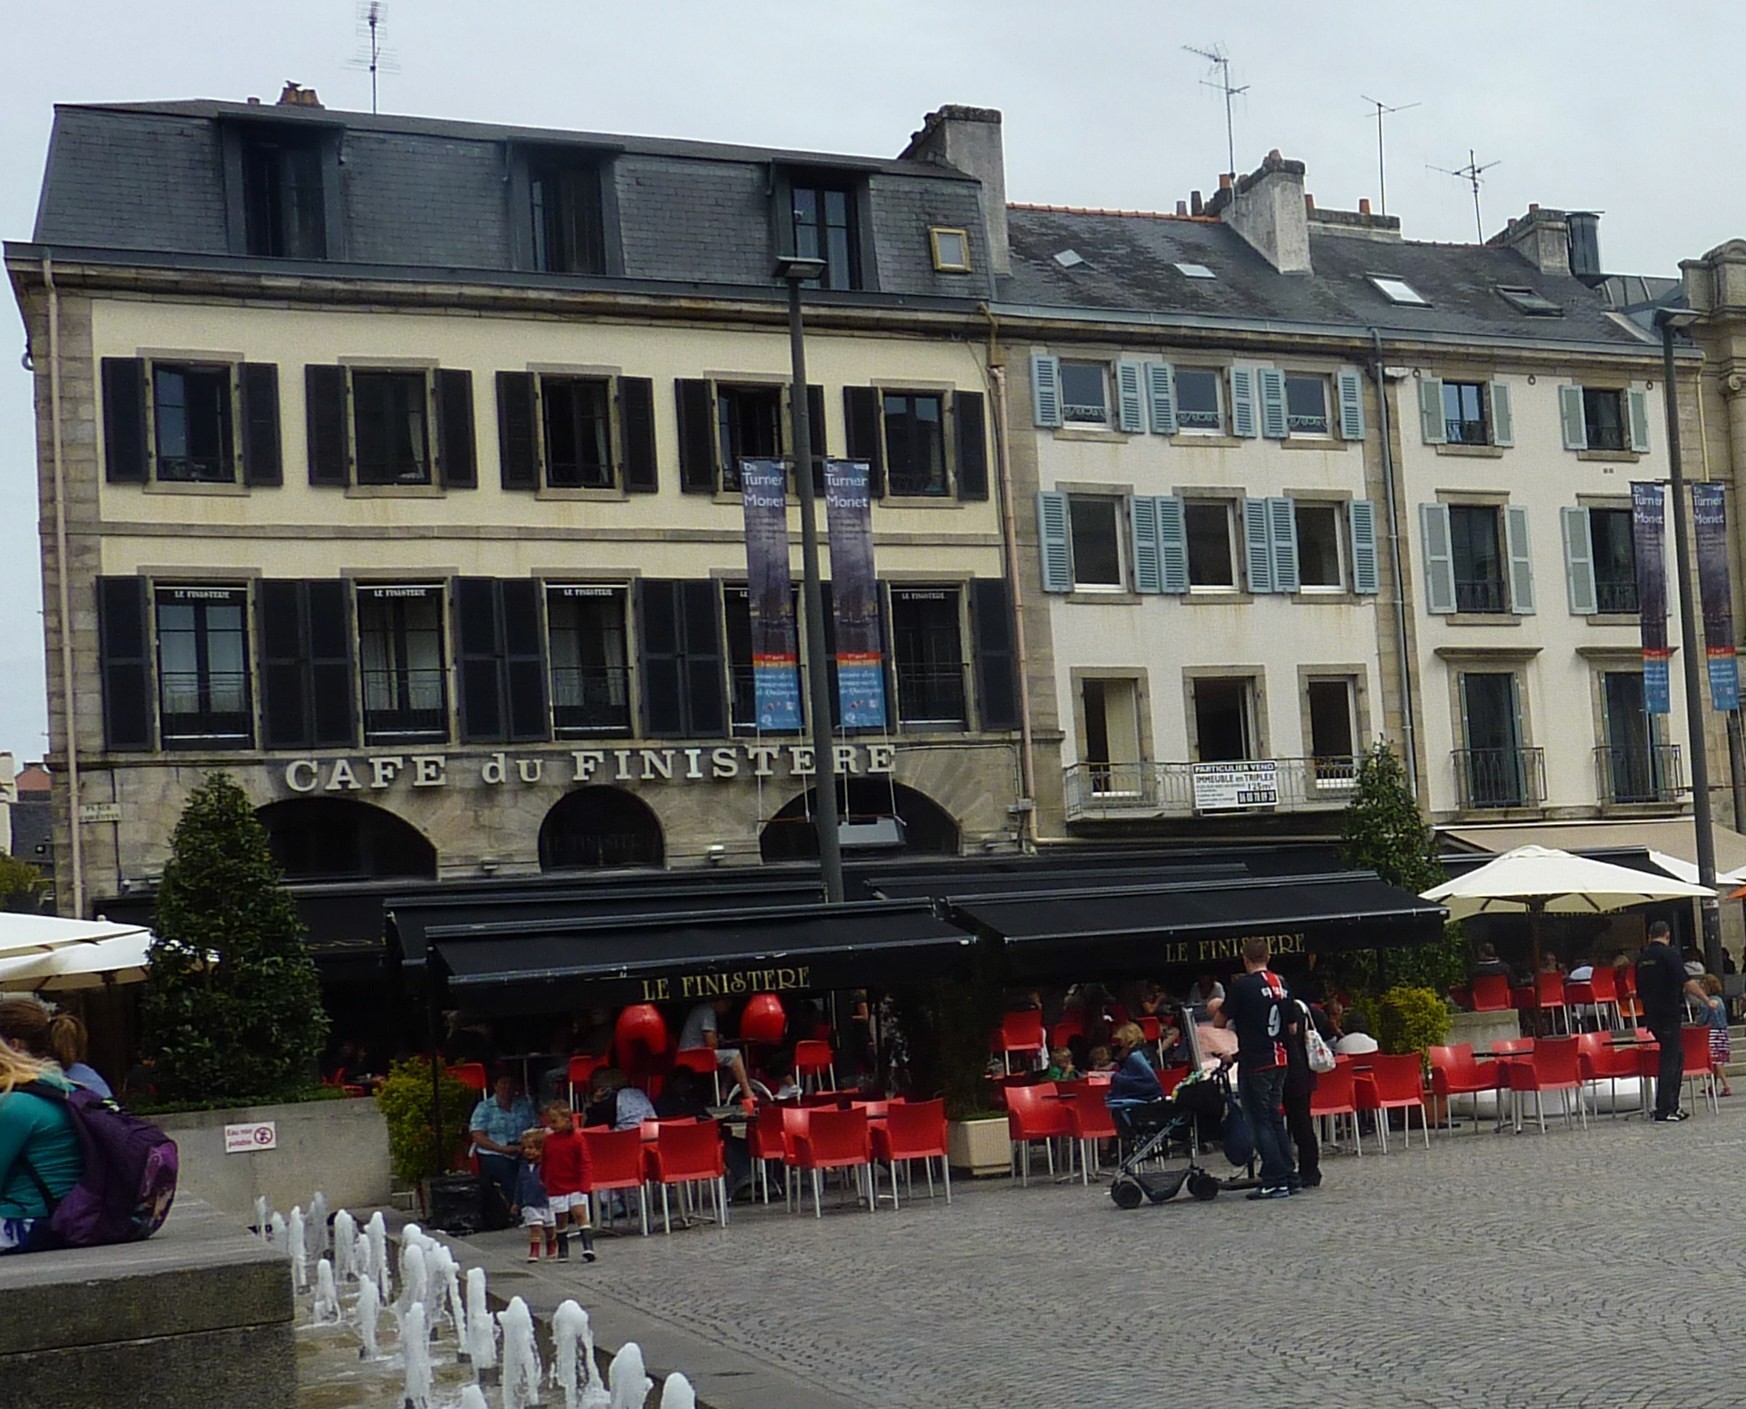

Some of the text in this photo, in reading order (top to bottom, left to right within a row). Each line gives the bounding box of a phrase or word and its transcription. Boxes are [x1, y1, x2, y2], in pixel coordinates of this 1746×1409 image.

[742, 472, 783, 486] Turner
[825, 473, 867, 487] Turner
[744, 494, 784, 507] Monet
[826, 495, 868, 508] Monet
[285, 744, 896, 792] CAFE du FINISTERE
[1195, 763, 1274, 773] PARTICULIER VEND
[1196, 774, 1233, 783] IMMEUBLE
[1244, 772, 1274, 782] TRIPLEX
[1166, 942, 1188, 962] LE
[642, 966, 811, 1000] LE FINISTERE
[1268, 1004, 1281, 1037] 9
